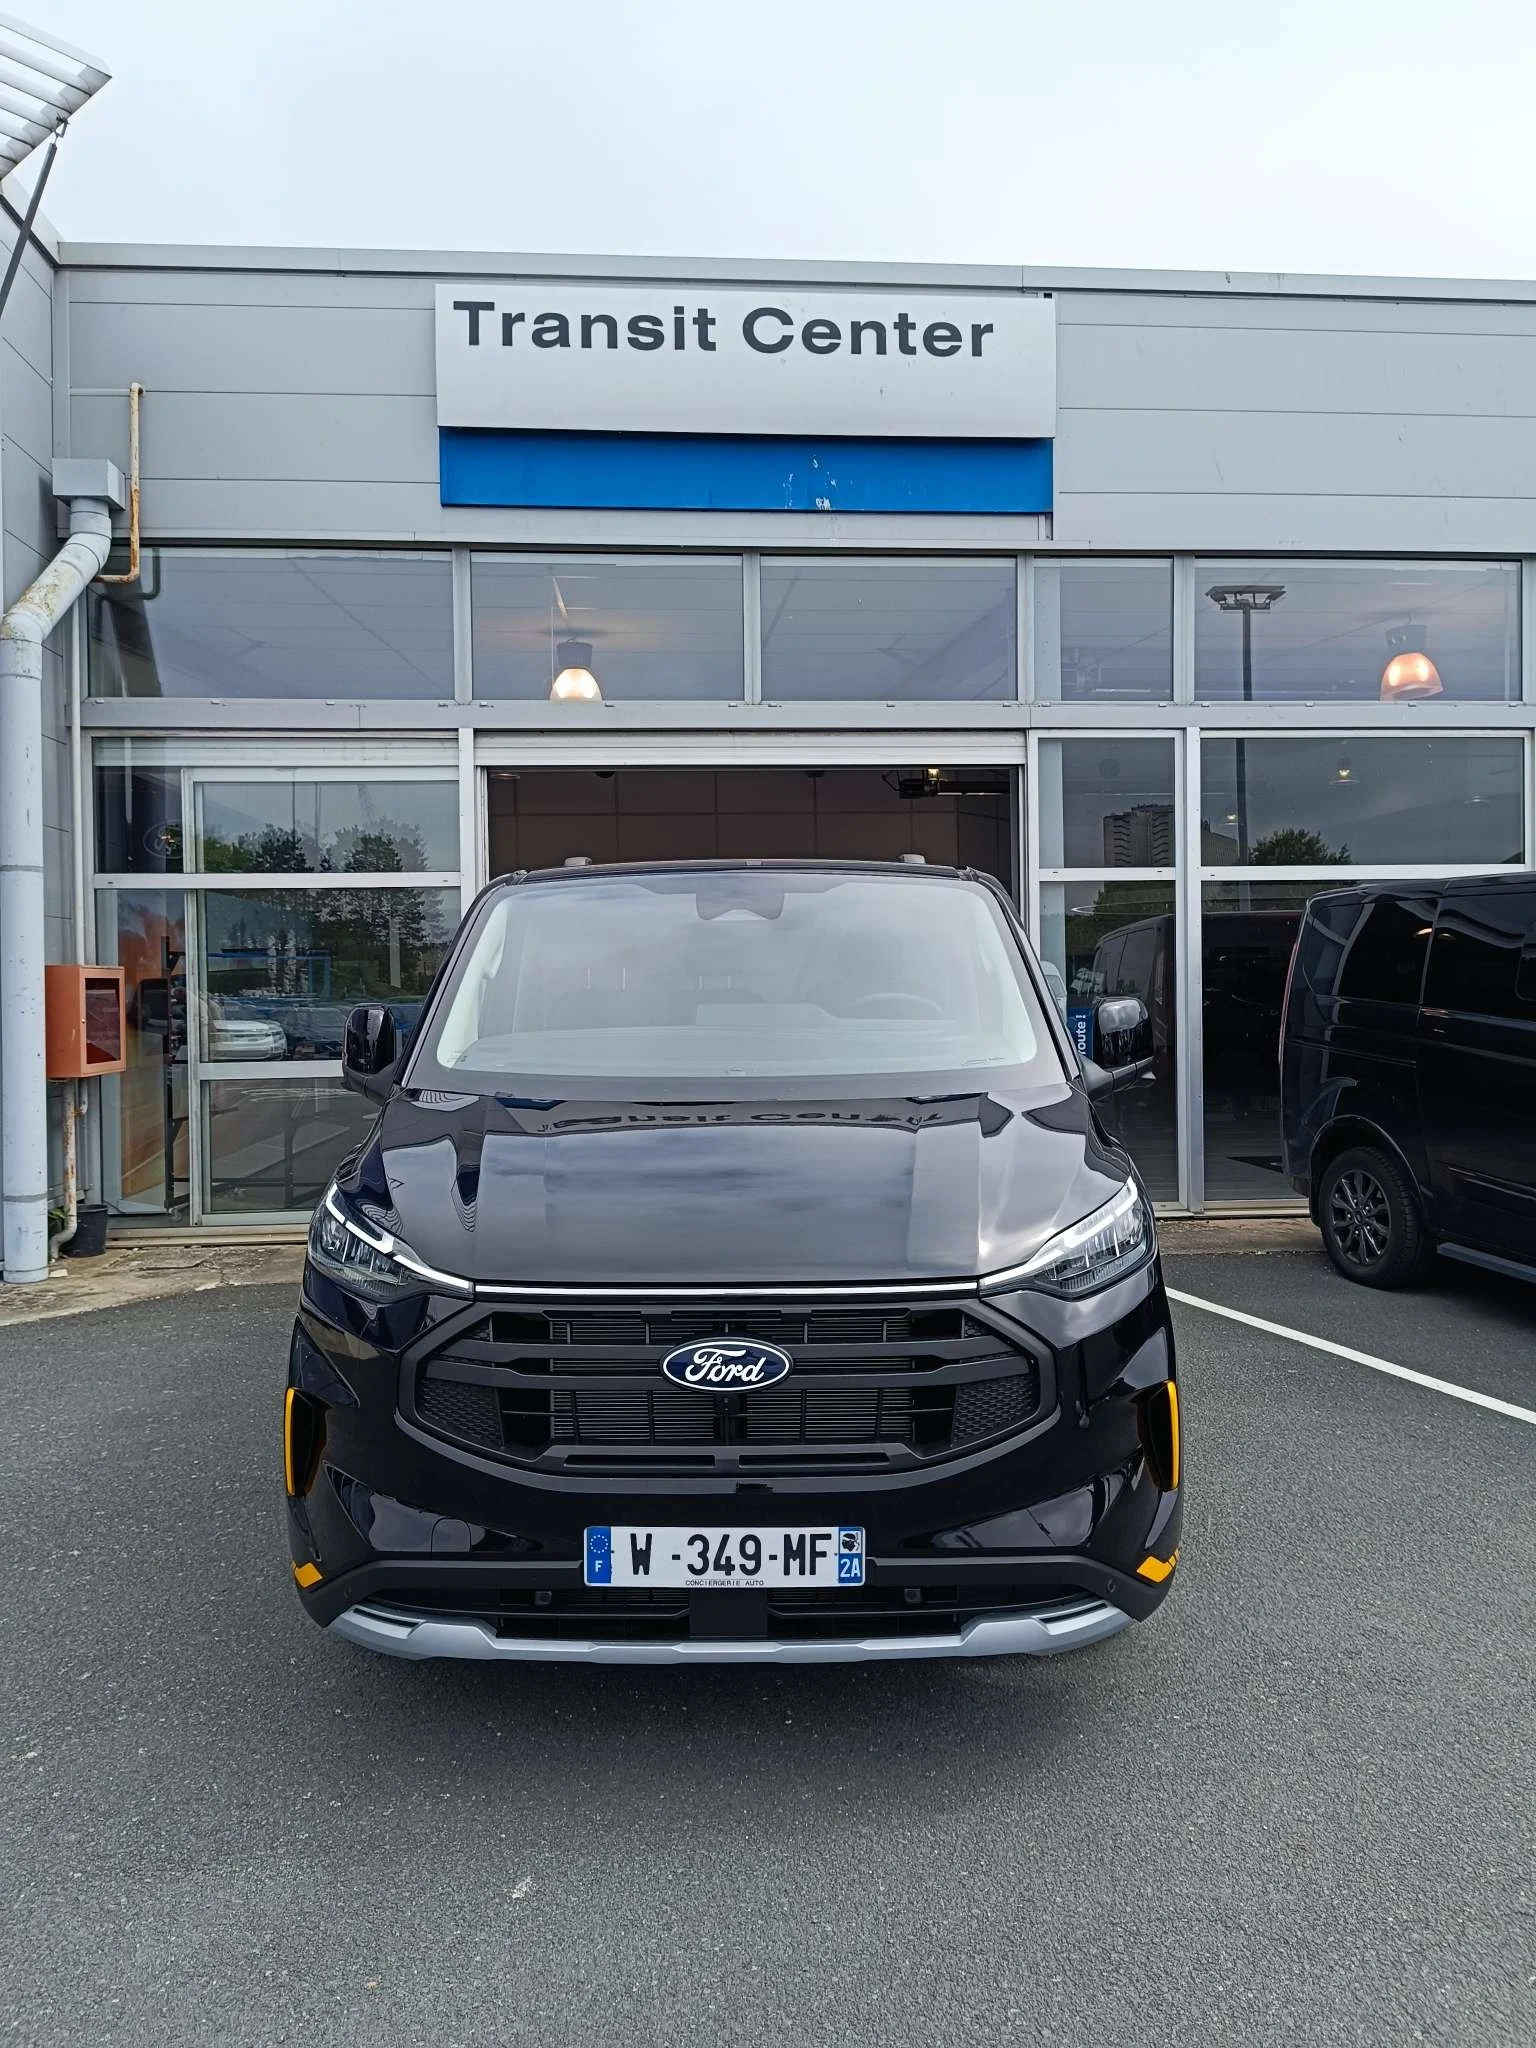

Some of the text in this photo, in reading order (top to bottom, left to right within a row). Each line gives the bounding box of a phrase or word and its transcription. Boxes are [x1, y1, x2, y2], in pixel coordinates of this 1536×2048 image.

[452, 300, 995, 358] Transit Center
[684, 1348, 767, 1382] Ford
[594, 1560, 603, 1573] F
[840, 1558, 862, 1578] 2A
[685, 1579, 765, 1587] CONCIERGERIE AUTO
